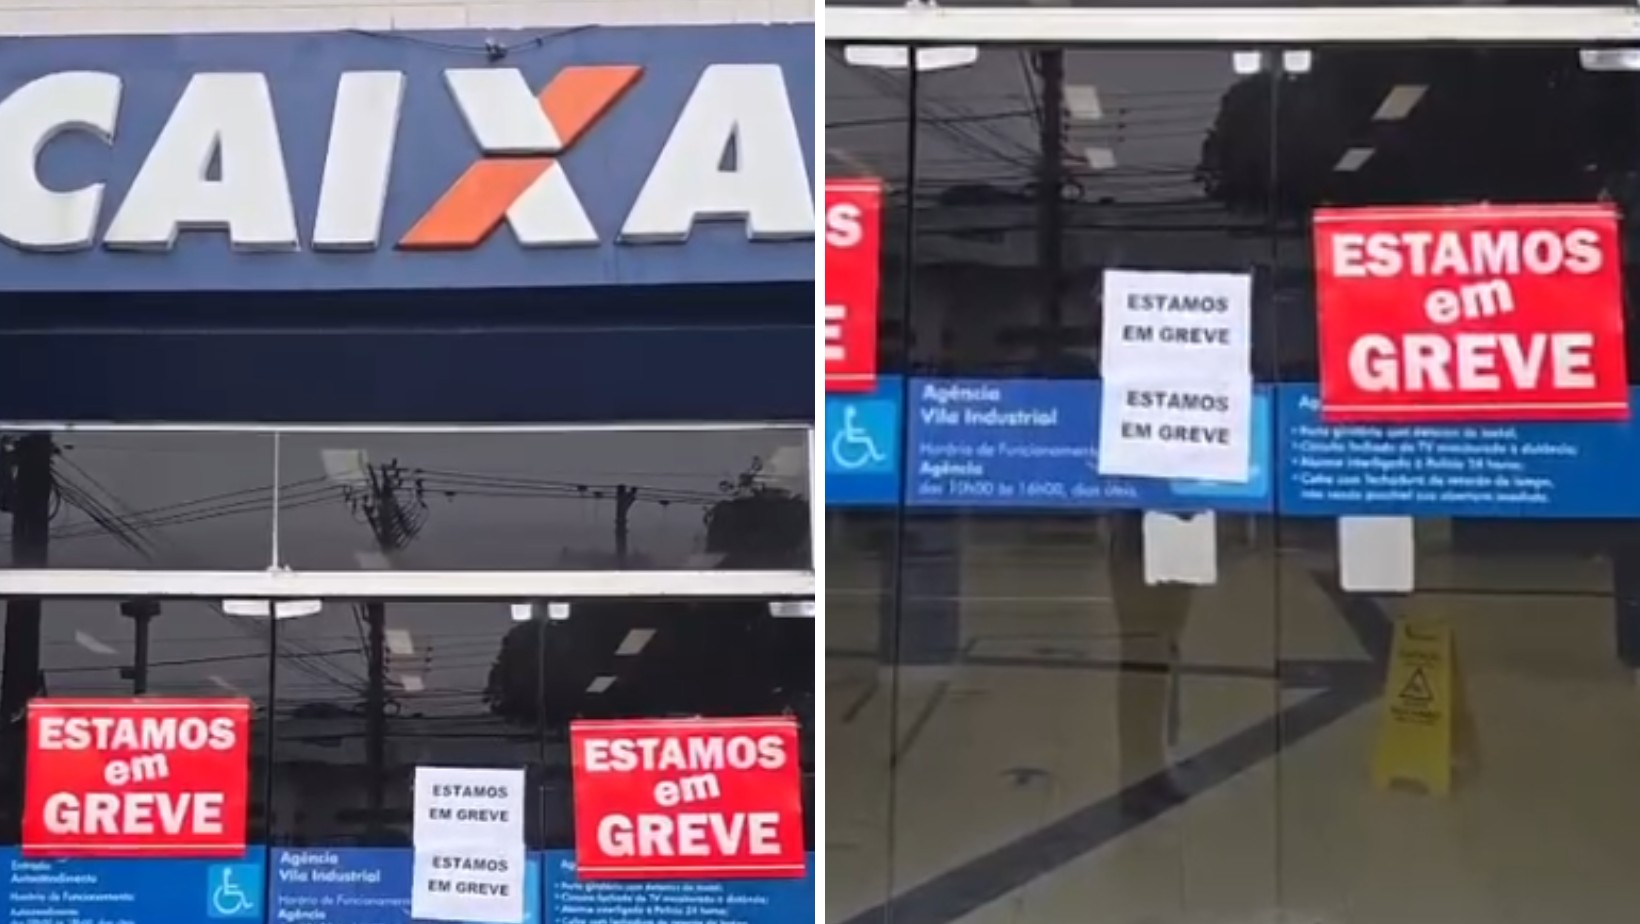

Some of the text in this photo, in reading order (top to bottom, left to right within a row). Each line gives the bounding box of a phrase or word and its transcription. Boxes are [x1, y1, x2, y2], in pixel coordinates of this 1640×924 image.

[0, 64, 815, 250] CAIXA
[1331, 229, 1603, 277] ESTAMOS
[1127, 293, 1229, 313] ESTAMOS
[1425, 278, 1515, 324] em
[1122, 325, 1230, 345] EM GREVE
[1348, 332, 1597, 392] GREVE
[922, 384, 1000, 403] Agência
[1126, 390, 1229, 411] ESTAMOS
[920, 408, 1057, 426] Vila Industrial
[1121, 422, 1230, 445] EM GREVE
[999, 442, 1098, 458] Funcionament
[919, 461, 982, 477] Agência
[38, 717, 236, 750] ESTAMOS
[584, 735, 786, 772] ESTAMOS
[104, 752, 169, 786] em
[432, 784, 508, 800] ESTAMOS
[654, 772, 720, 807] em
[43, 791, 224, 835] GREVE
[429, 808, 509, 823] EM GREVE
[597, 812, 781, 857] GREVE
[280, 851, 338, 866] Agência
[432, 856, 508, 872] ESTAMOS
[279, 868, 381, 884] Vila Industrial
[428, 879, 509, 897] EM GREVE
